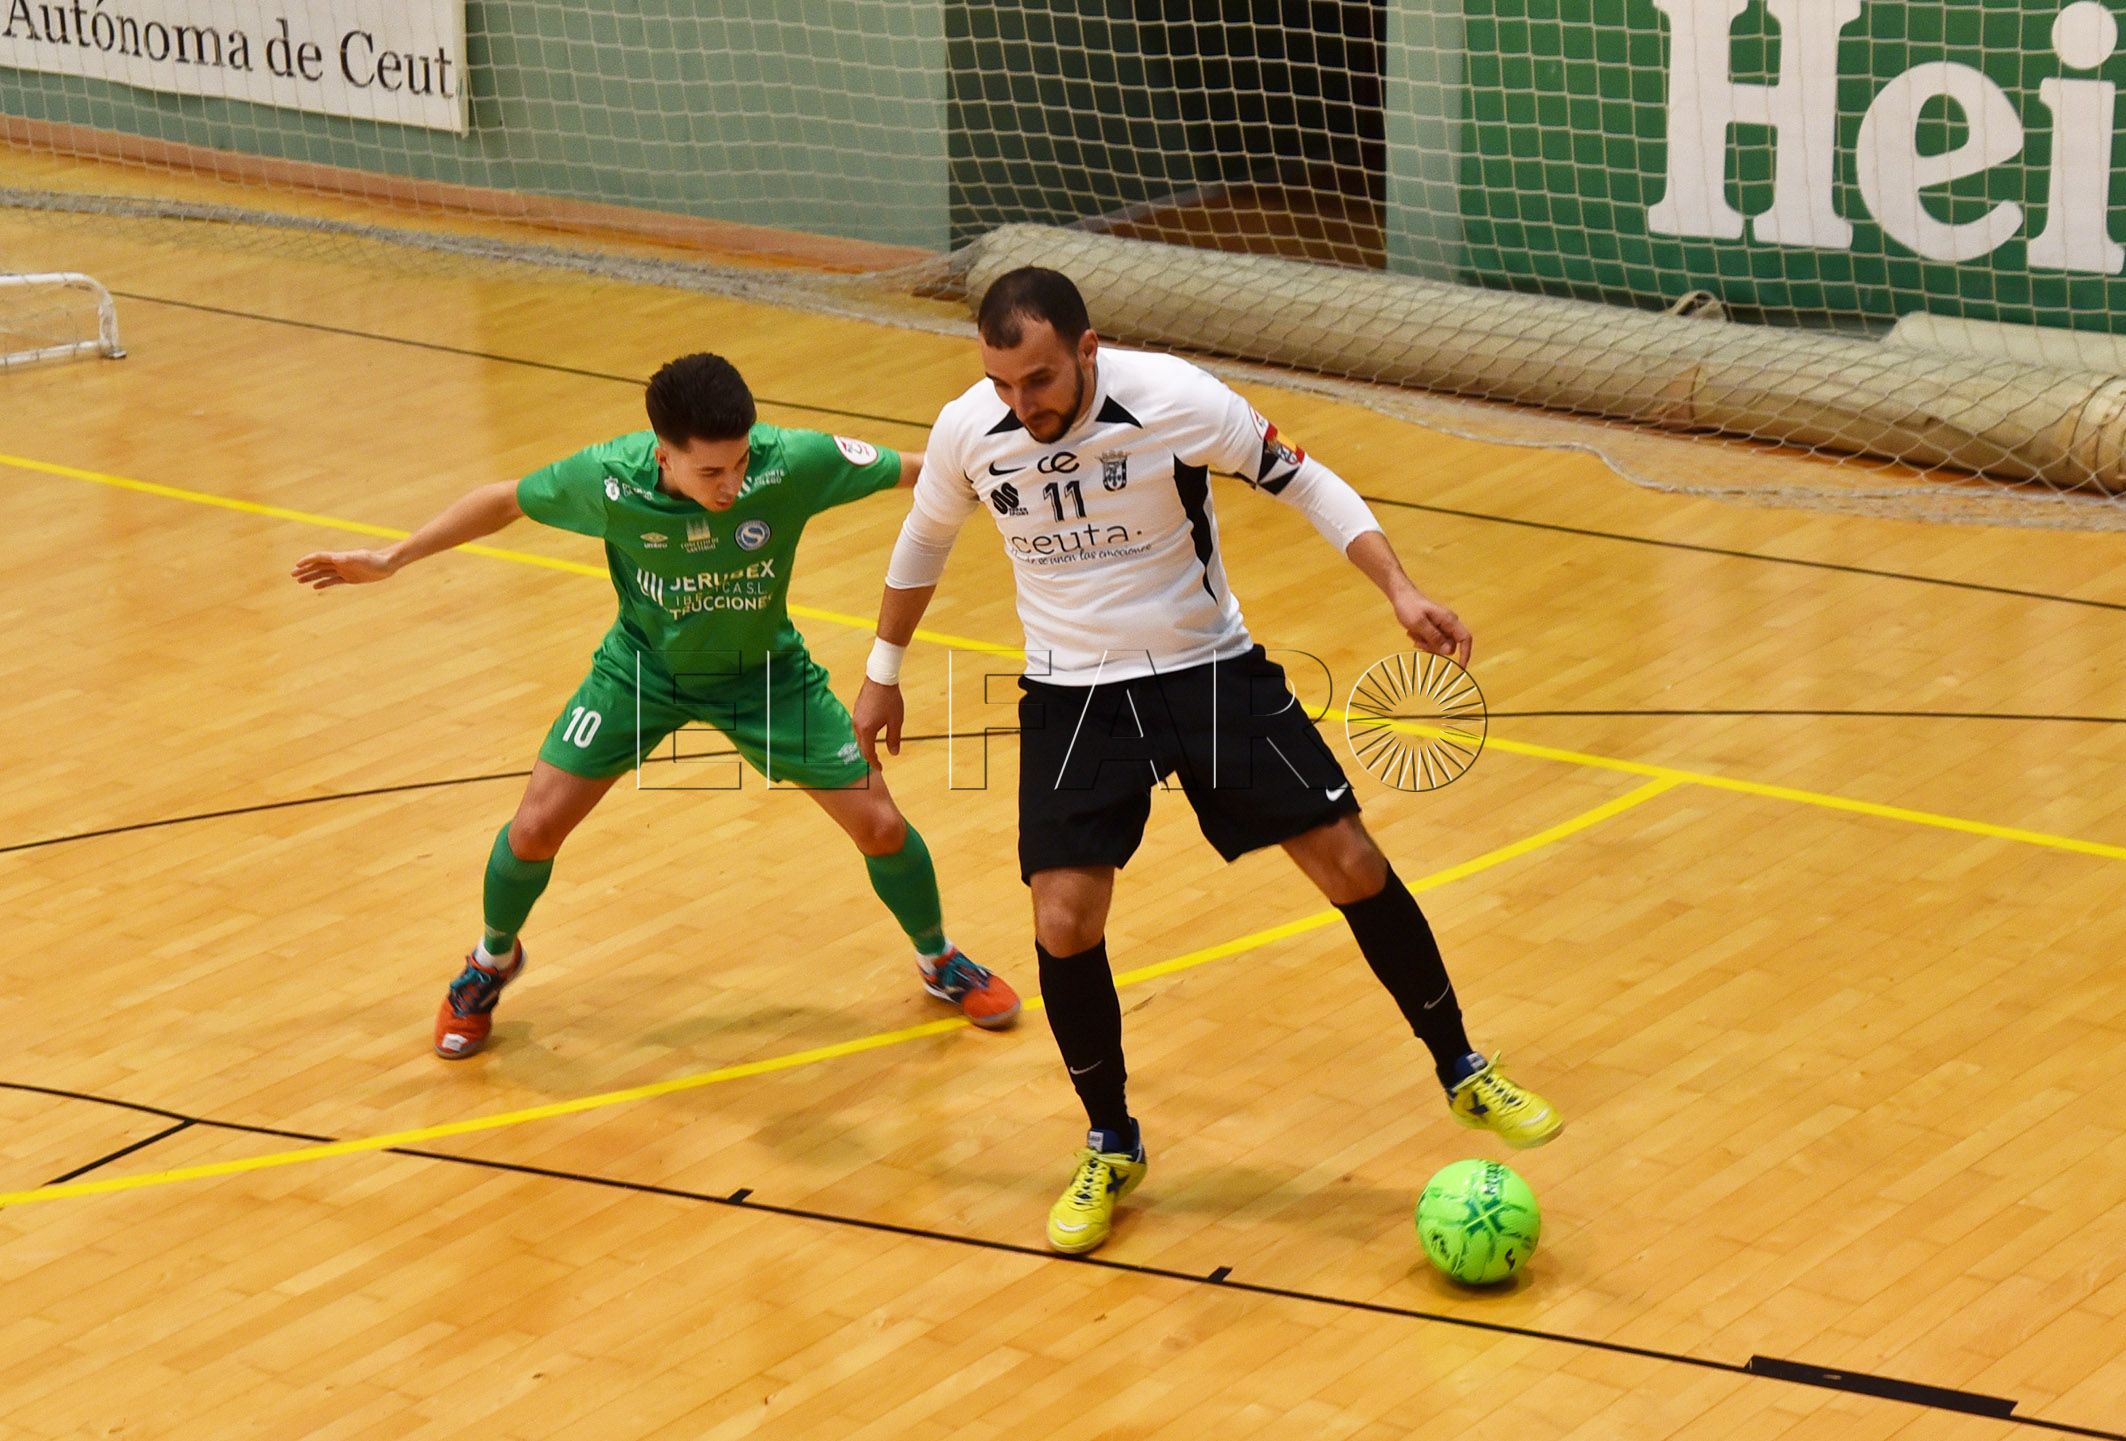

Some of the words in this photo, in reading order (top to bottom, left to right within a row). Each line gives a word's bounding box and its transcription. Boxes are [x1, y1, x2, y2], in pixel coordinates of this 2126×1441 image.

[1, 0, 254, 72] Autónoma
[265, 18, 324, 82] de
[1647, 0, 2126, 275] Hei
[1042, 480, 1087, 522] 11
[562, 705, 602, 749] 10
